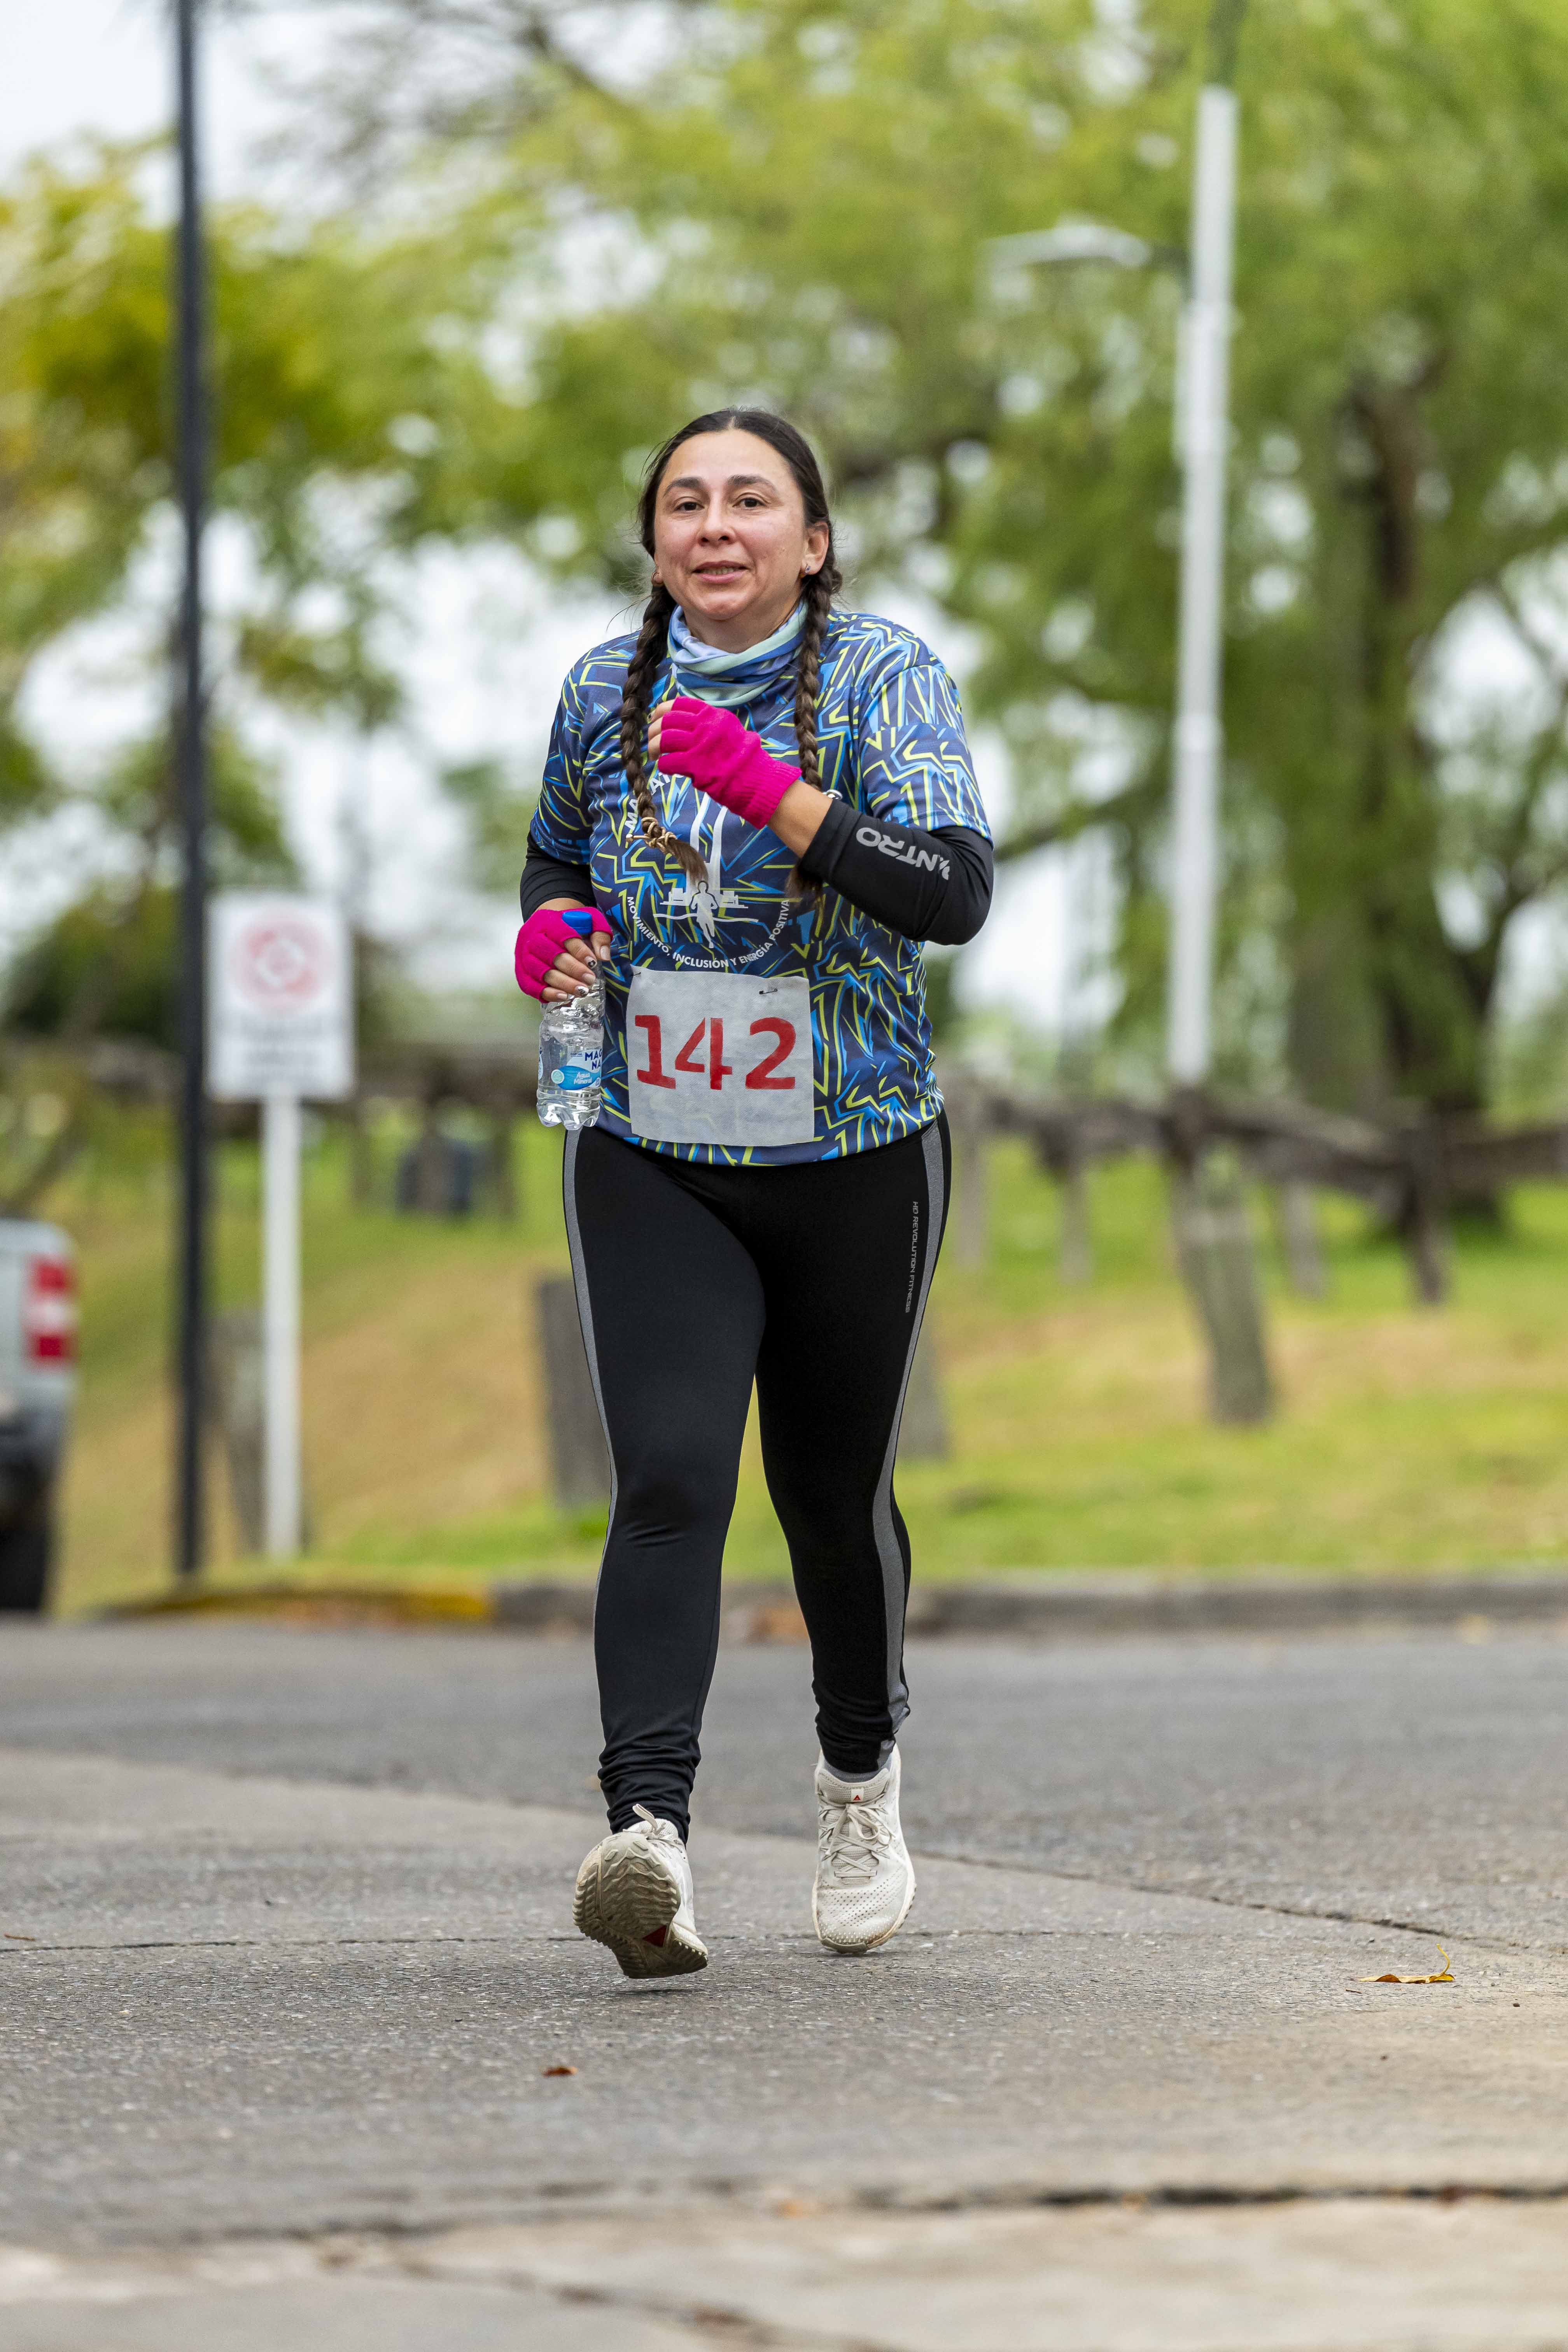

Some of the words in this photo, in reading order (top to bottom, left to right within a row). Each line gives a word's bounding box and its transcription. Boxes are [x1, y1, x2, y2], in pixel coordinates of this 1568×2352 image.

[627, 897, 670, 956] MOVIMIENTO,
[673, 952, 729, 968] INCLUSIÓN
[738, 942, 773, 964] ENERGÍA
[769, 899, 790, 941] POSITIVA
[635, 1015, 796, 1090] 142
[910, 1216, 919, 1273] REVOLUTION
[905, 1275, 915, 1313] FITNESS
